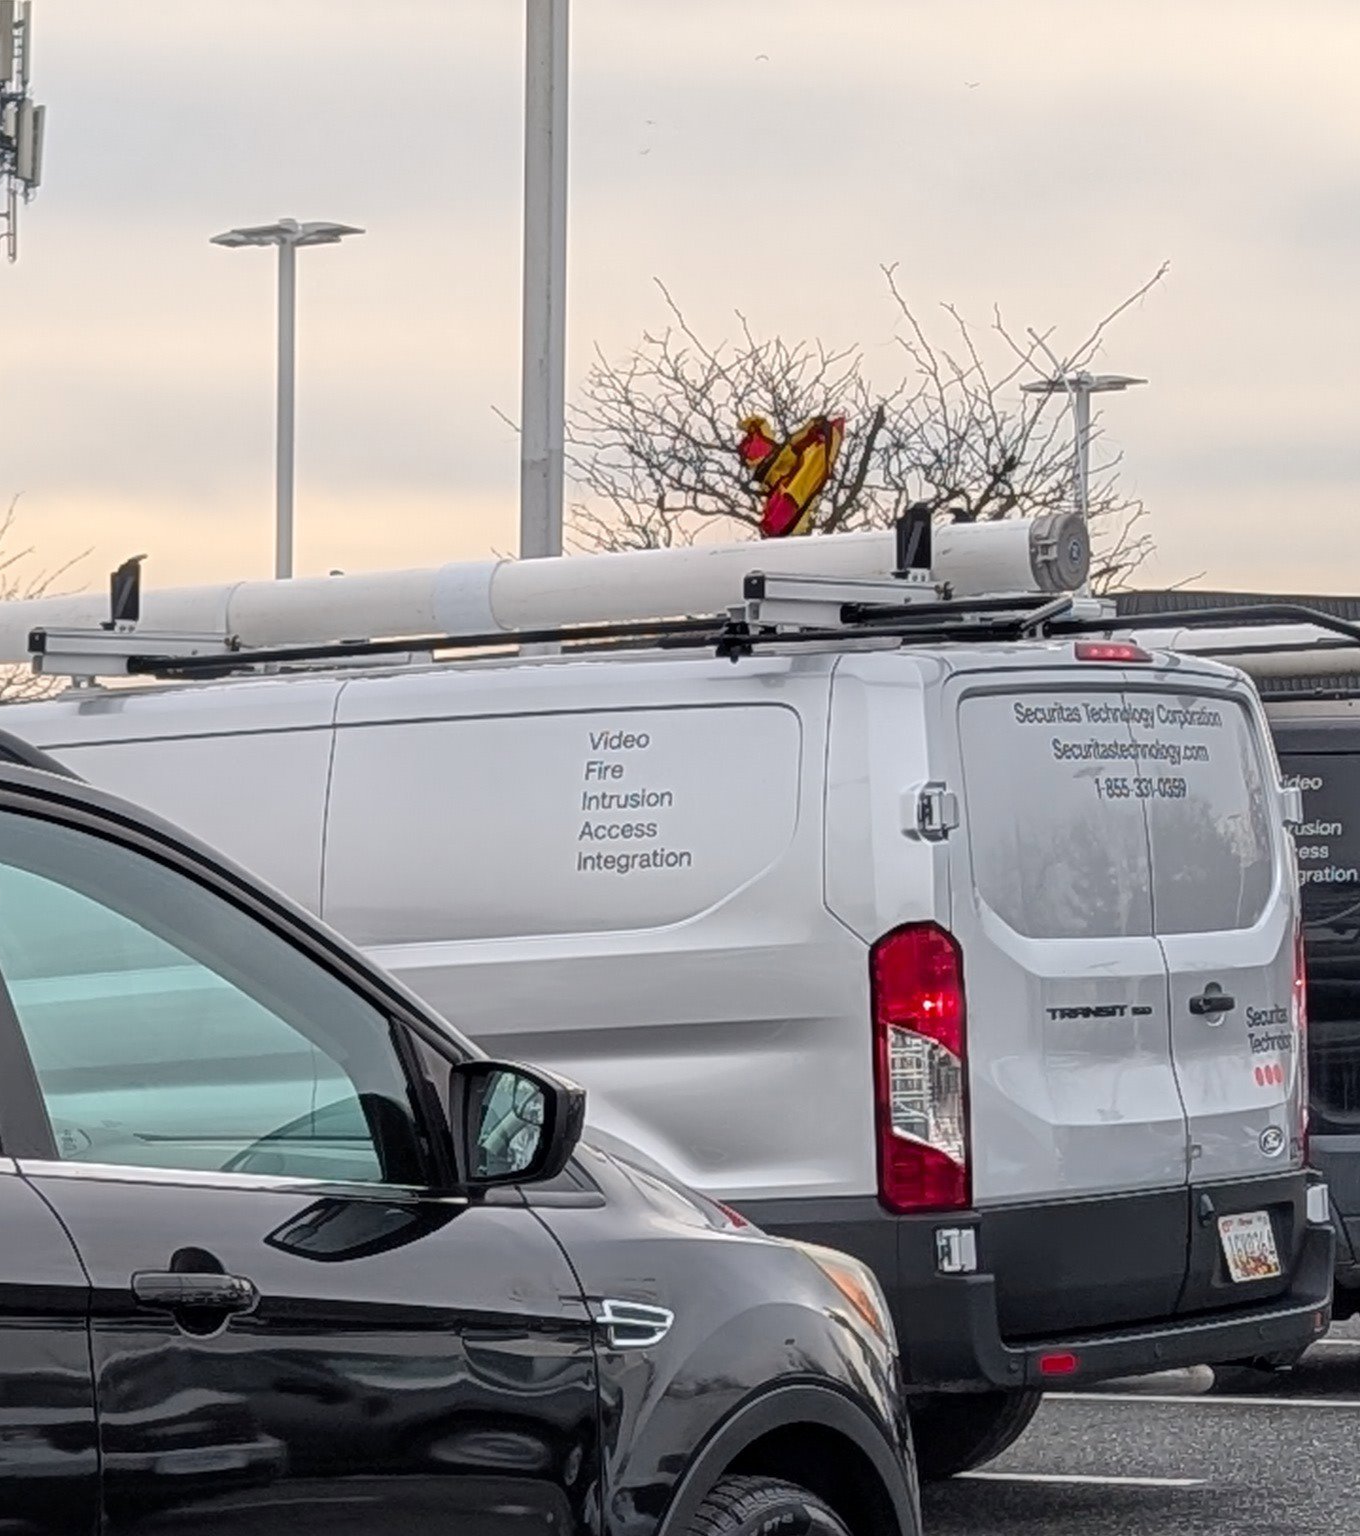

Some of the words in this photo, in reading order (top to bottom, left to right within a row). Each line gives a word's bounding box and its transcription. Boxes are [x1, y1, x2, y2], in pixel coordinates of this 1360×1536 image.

[1014, 702, 1081, 724] Securitas
[1082, 702, 1155, 729] Technology
[1156, 704, 1223, 729] Corporation
[589, 731, 650, 751] Video
[1052, 738, 1209, 765] Securitastechnology.com
[585, 761, 624, 781] Fire
[1281, 774, 1323, 790] ideo
[582, 788, 673, 811] Intrusion
[578, 821, 658, 841] Access
[1287, 820, 1342, 836] rusion
[577, 848, 692, 874] Integration
[1294, 845, 1329, 859] ess
[1297, 865, 1359, 887] gration
[1046, 1004, 1128, 1020] TRANSIT
